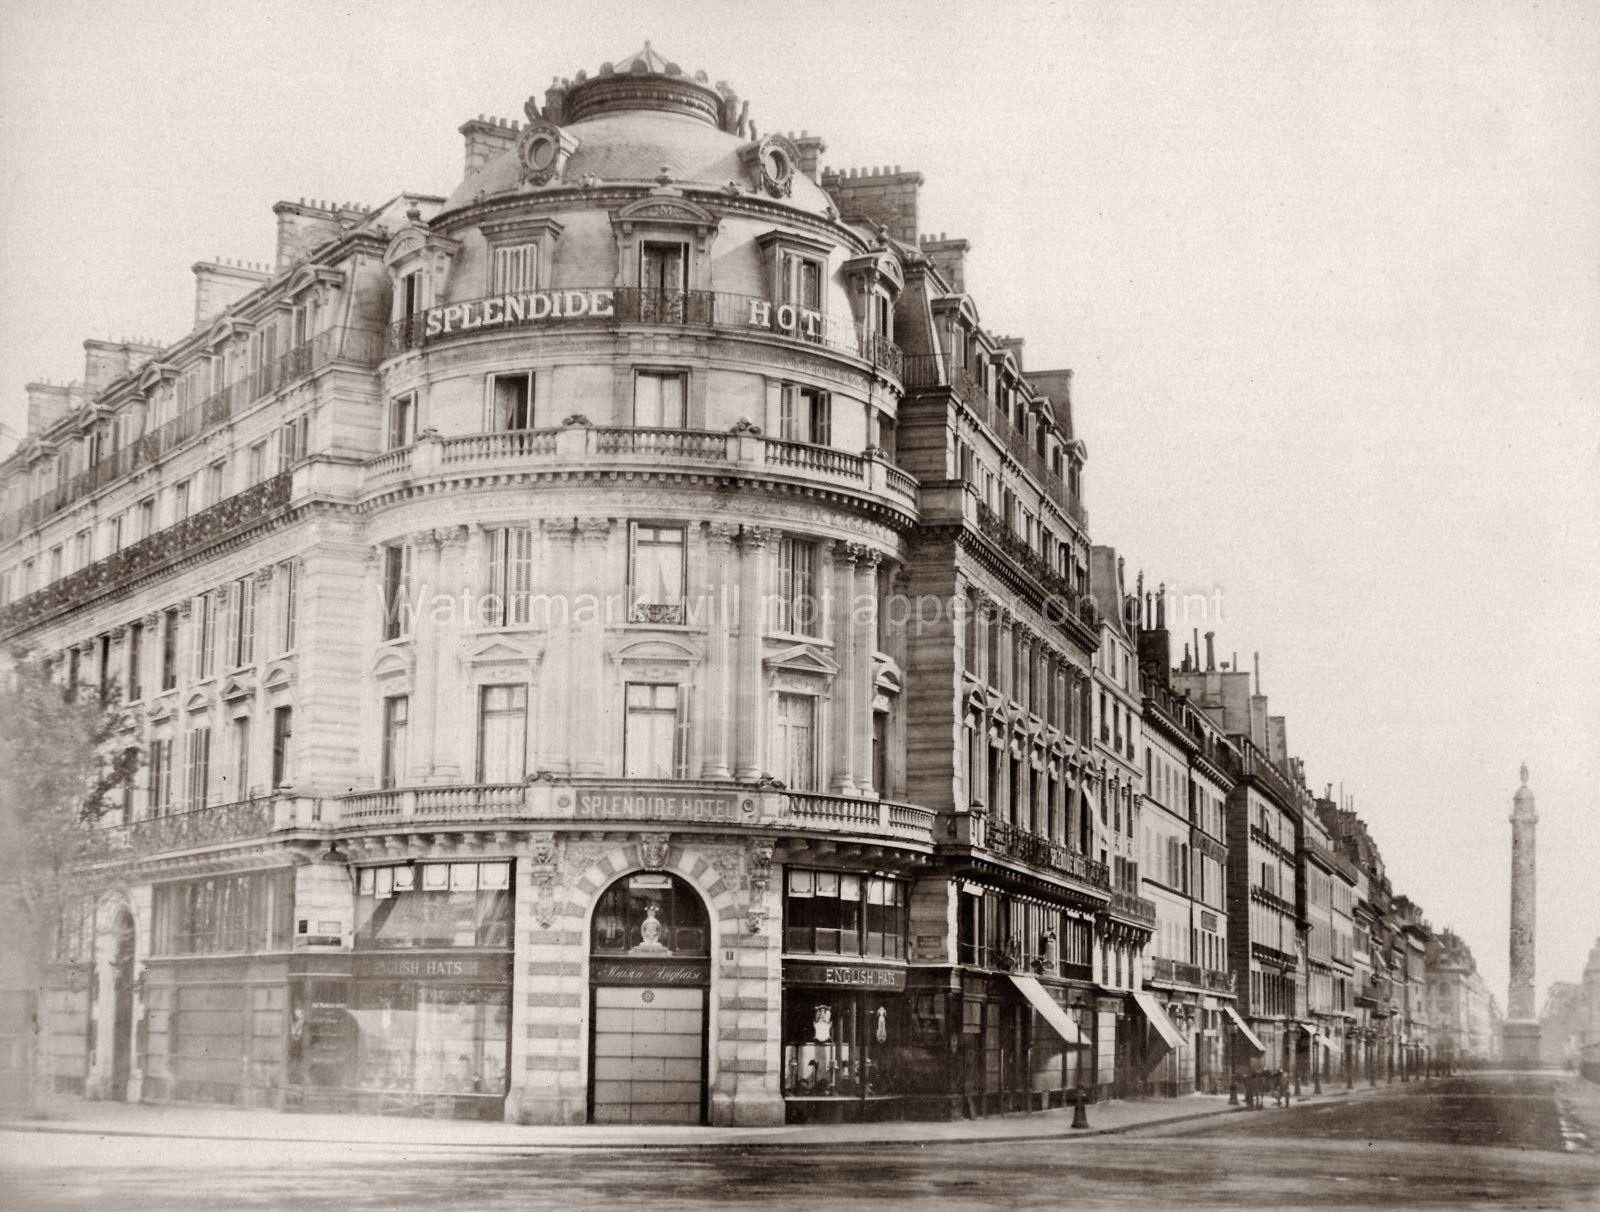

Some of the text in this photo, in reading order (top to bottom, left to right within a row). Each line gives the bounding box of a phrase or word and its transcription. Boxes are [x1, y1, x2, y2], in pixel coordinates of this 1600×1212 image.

[426, 291, 614, 336] SPLENDIDE
[581, 796, 735, 819] SPLENDIDE HOTEL
[426, 961, 463, 975] HATS
[826, 968, 896, 986] ENGLISH HATS
